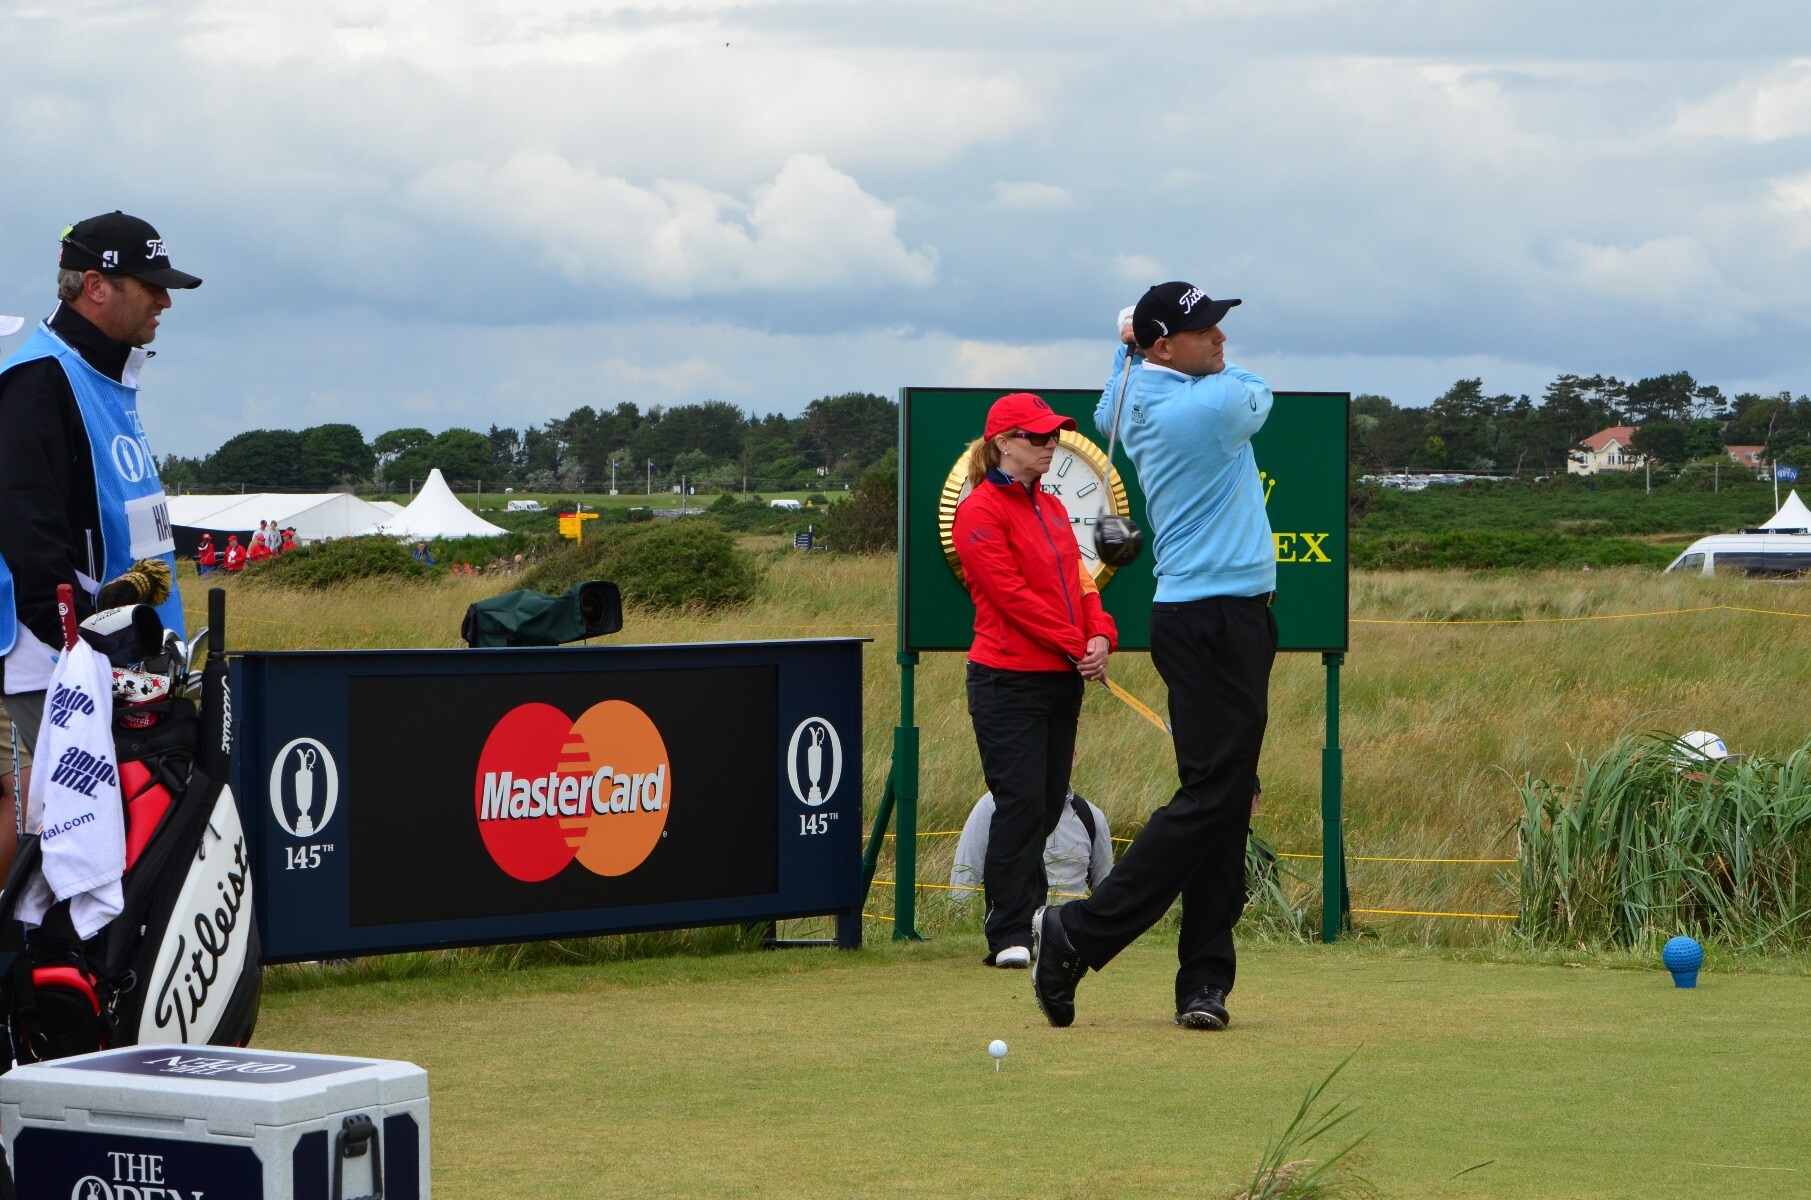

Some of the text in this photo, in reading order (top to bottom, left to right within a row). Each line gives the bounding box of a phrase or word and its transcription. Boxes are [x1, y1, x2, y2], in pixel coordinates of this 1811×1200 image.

[145, 238, 169, 260] Tit
[50, 762, 99, 798] VITAL
[479, 763, 667, 822] MasterCard
[155, 835, 249, 1045] Titleist
[107, 1151, 165, 1185] THE
